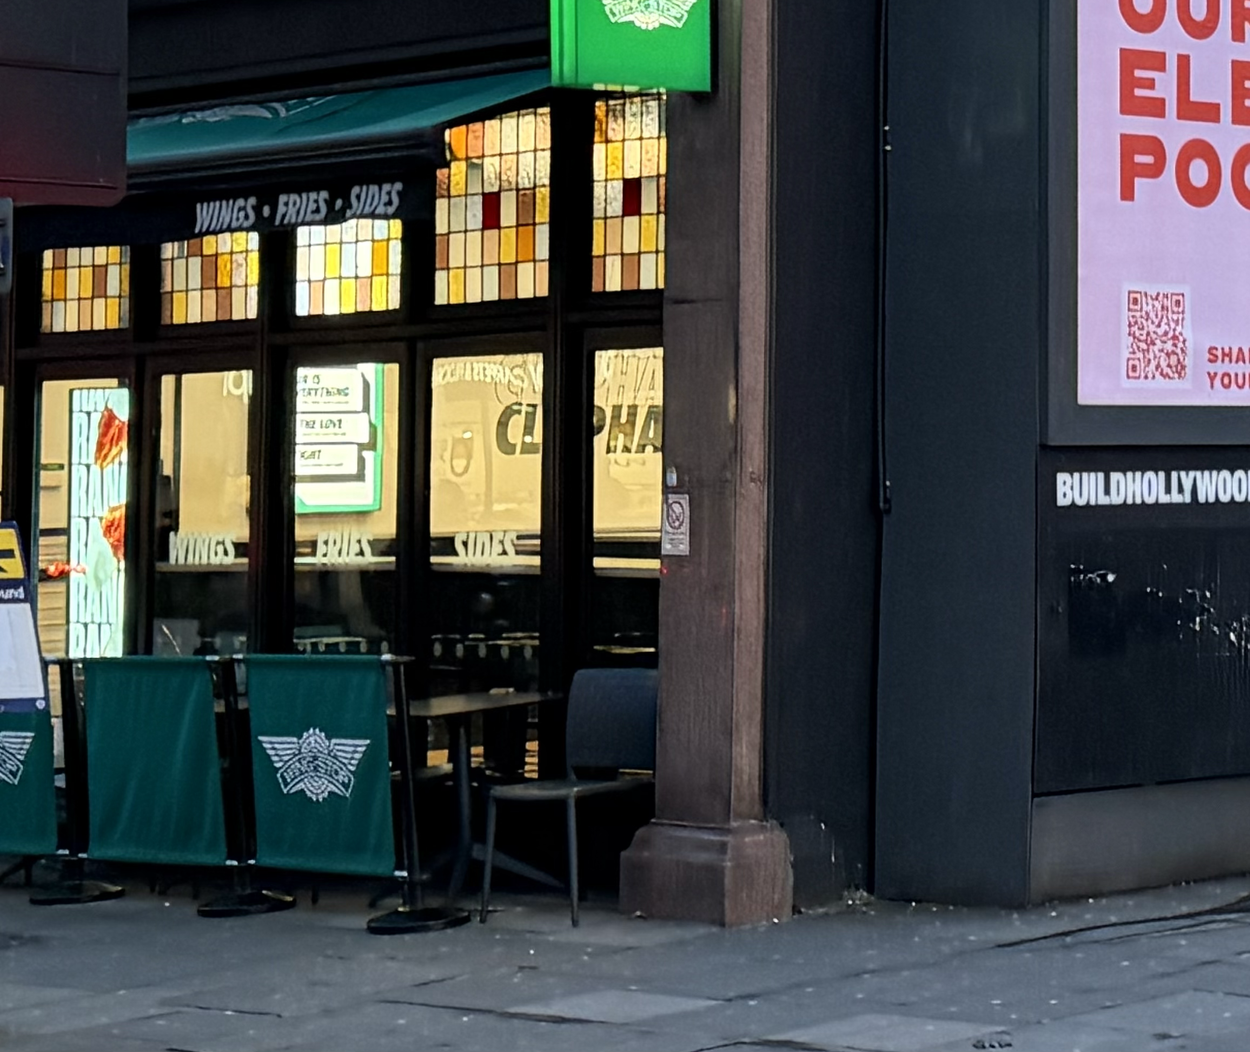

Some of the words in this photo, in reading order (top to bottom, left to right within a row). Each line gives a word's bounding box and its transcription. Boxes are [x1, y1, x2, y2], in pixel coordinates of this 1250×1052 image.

[194, 195, 257, 234] WINGS
[274, 190, 329, 226] FRIES
[345, 182, 404, 218] SIDES
[168, 531, 236, 565] WINGS
[316, 531, 374, 565] FRIES
[453, 531, 518, 566] SIDES
